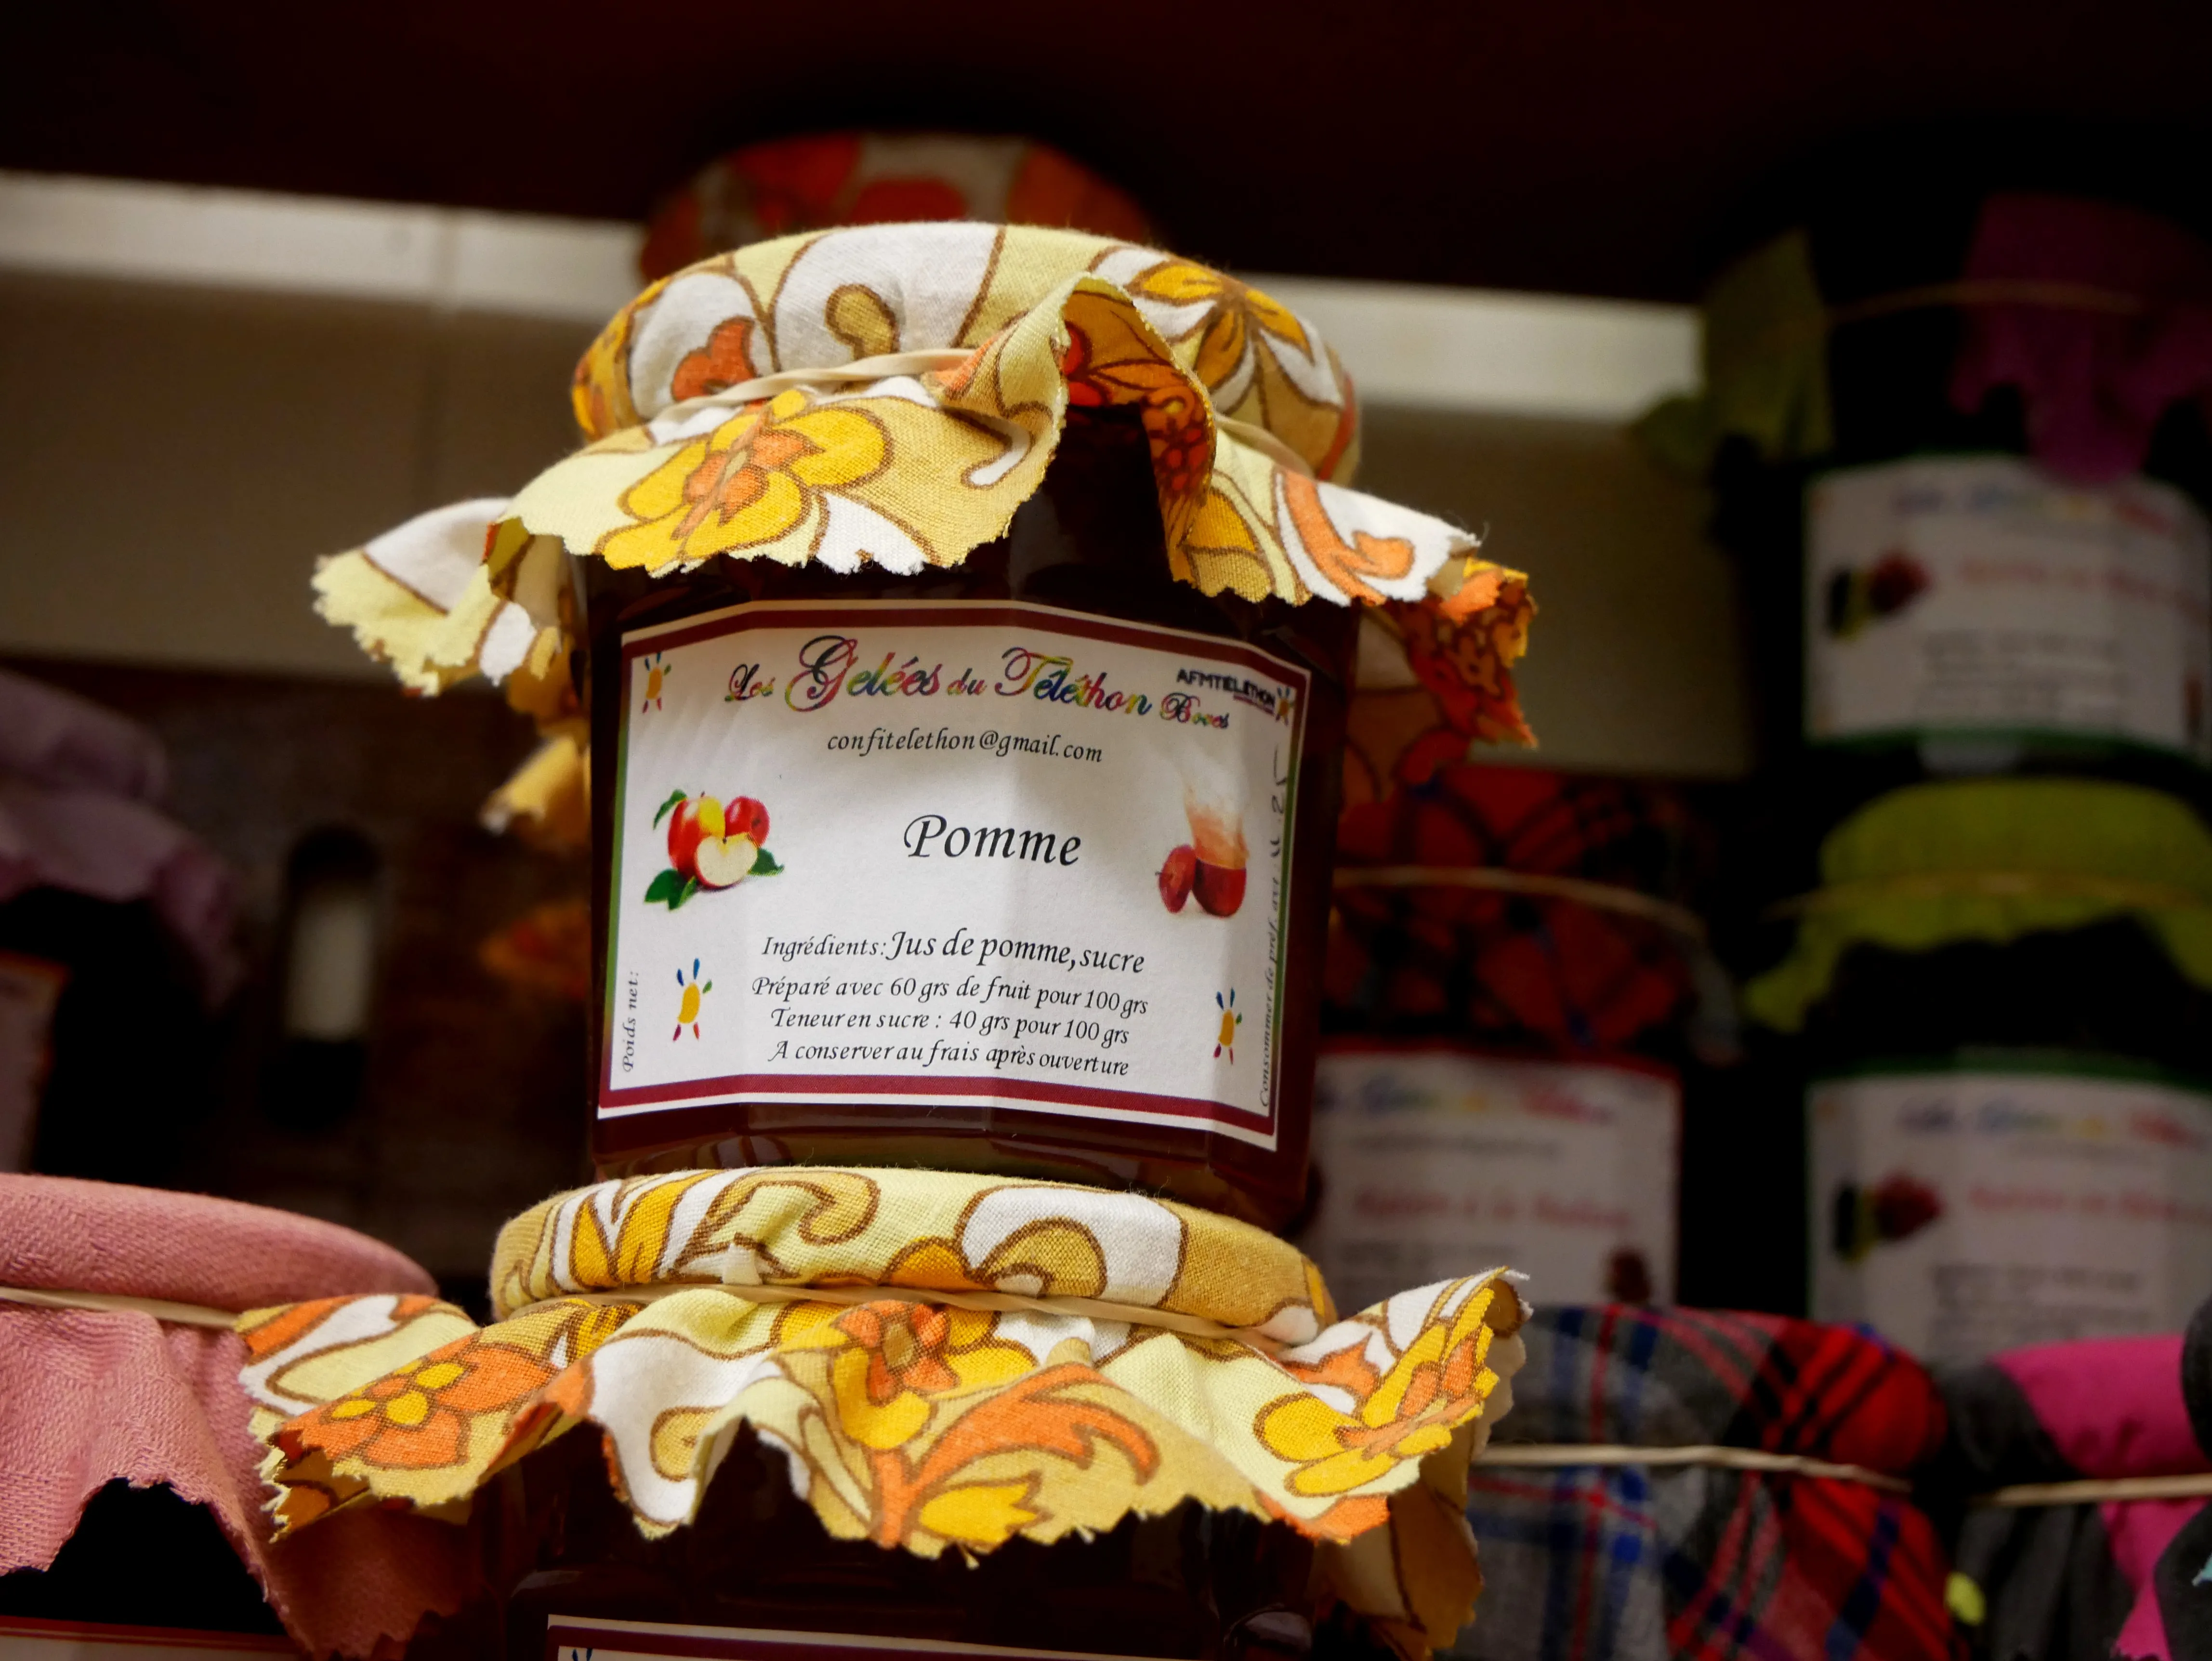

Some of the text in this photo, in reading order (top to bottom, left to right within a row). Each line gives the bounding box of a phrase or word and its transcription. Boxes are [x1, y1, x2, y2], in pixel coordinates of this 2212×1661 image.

[724, 663, 775, 702] Les
[785, 635, 943, 712] Gelées
[947, 668, 988, 696] du
[994, 647, 1153, 715] Téléthon
[828, 727, 1102, 763] confitelethon@gmail.com
[904, 815, 1081, 867] Pomme
[885, 931, 937, 961] Jus
[942, 927, 974, 956] de
[751, 975, 1148, 1019] Préparé avec 60 grs de fruit pour 100 grs
[622, 1017, 636, 1072] Poids
[771, 1008, 846, 1028] Teneur
[846, 1015, 871, 1028] en
[876, 1015, 931, 1029] sucre
[949, 1011, 977, 1029] 40
[979, 1015, 1010, 1036] grs
[1013, 1018, 1062, 1040] pour
[1064, 1019, 1100, 1041] 100
[1101, 1028, 1130, 1049] grs
[767, 1039, 1129, 1076] A conserver au frais après ouverture
[1260, 996, 1272, 1107] Consommer
